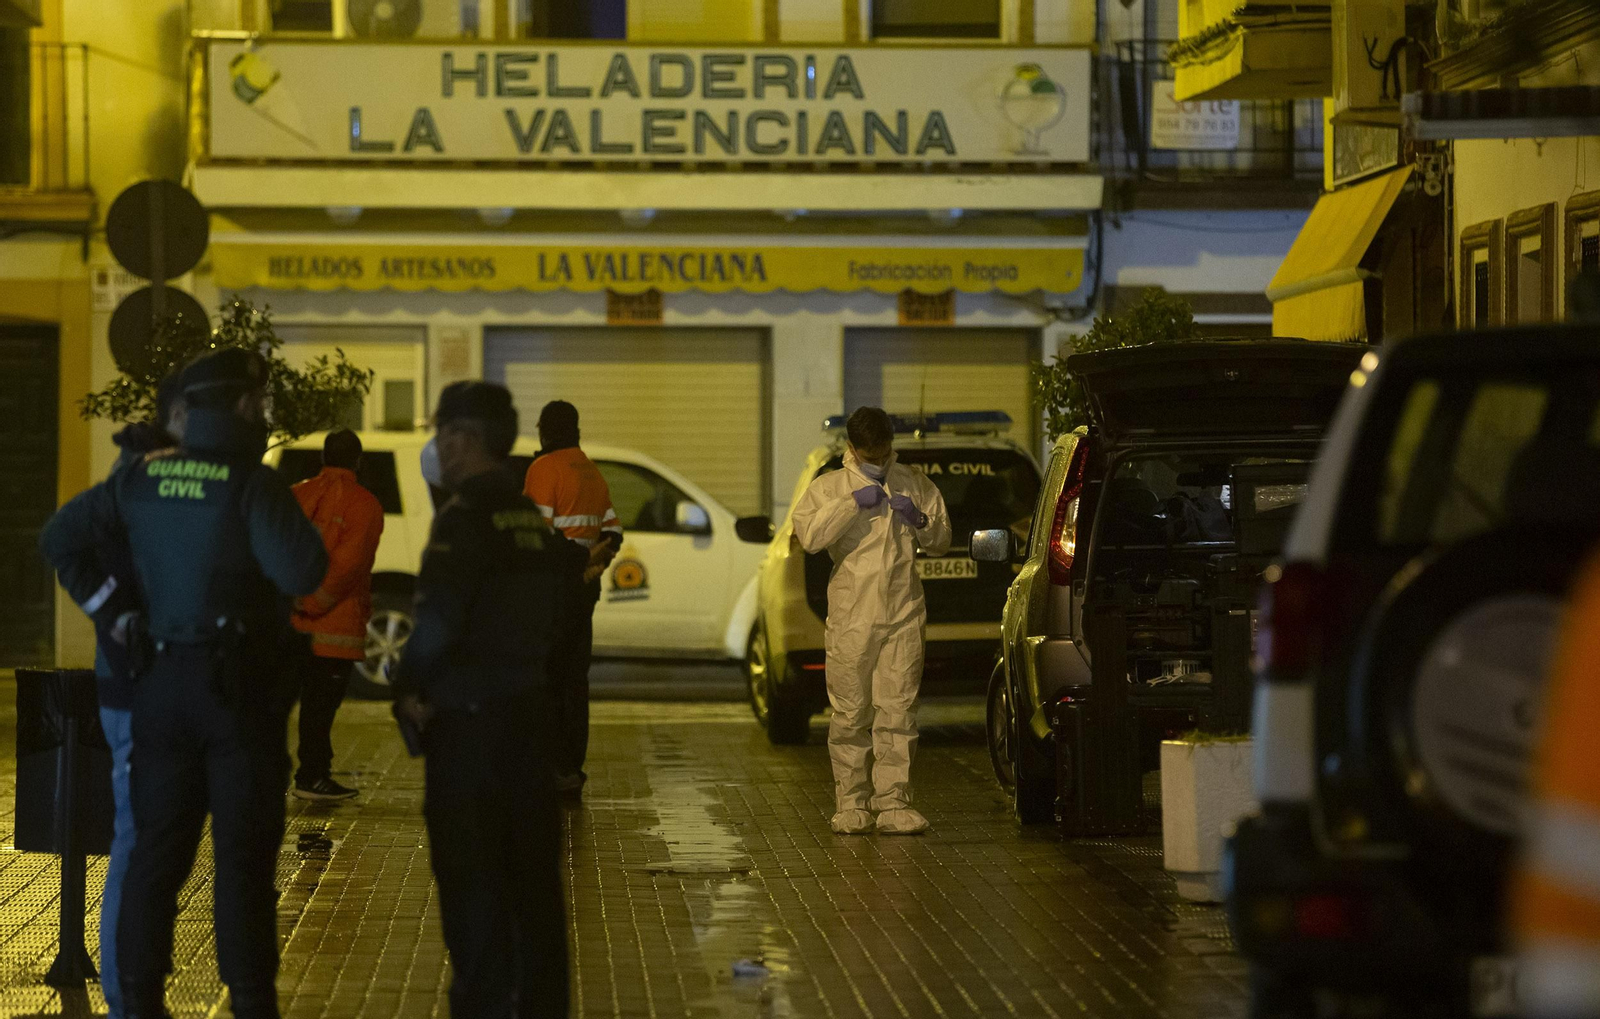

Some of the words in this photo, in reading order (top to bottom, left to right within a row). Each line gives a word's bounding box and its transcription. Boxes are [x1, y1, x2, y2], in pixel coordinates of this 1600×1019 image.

[442, 52, 864, 99] HELADERIA
[350, 106, 443, 154] LA
[504, 108, 957, 156] VALENCIANA
[269, 257, 362, 278] HELADOS
[380, 257, 496, 280] ARTESANOS
[537, 252, 572, 282] LA
[584, 252, 766, 283] VALENCIANA
[848, 261, 953, 282] Fabricación
[964, 262, 1019, 285] Propia
[147, 460, 230, 481] GUARDIA
[948, 462, 996, 476] CIVIL
[158, 479, 206, 499] CIVIL
